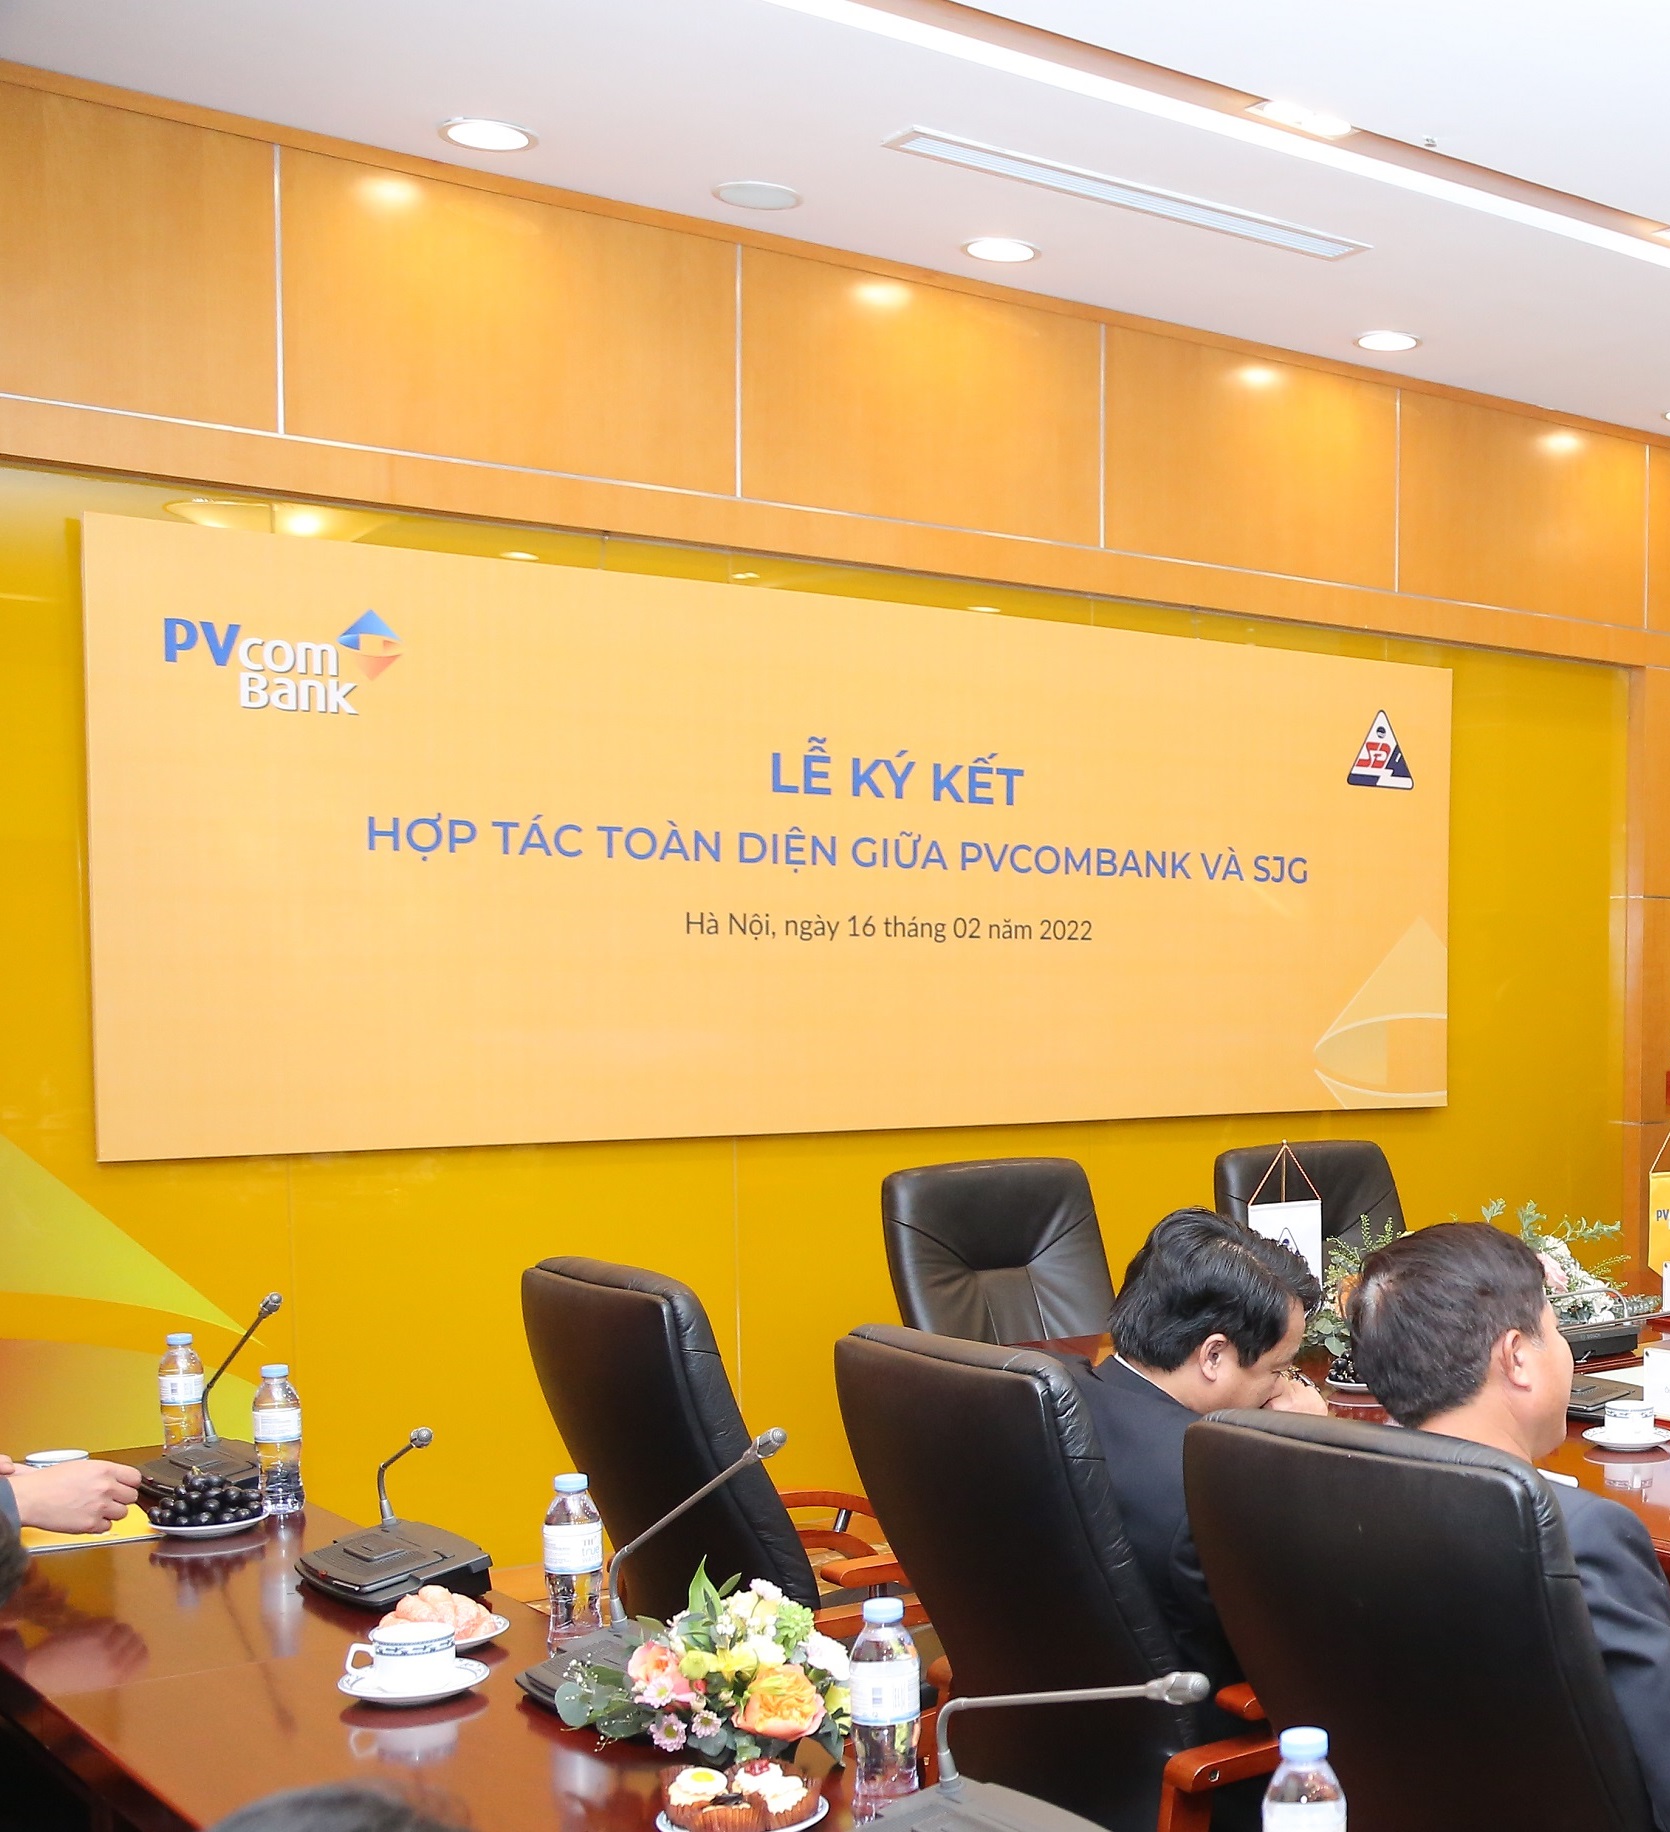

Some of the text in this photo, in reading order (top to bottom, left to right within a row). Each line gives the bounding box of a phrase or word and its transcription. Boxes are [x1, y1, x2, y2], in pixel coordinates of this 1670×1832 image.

[164, 617, 339, 677] PVcom
[239, 671, 359, 715] Bank
[772, 736, 1025, 806] LỄ KÝ KẾT
[367, 813, 1308, 885] HỢP TÁC TOÀN DIỆN GIỮA PVCOMBANK VÀ SJG
[686, 911, 1093, 944] Hà Nội, ngày 16 tháng 02 năm 2022
